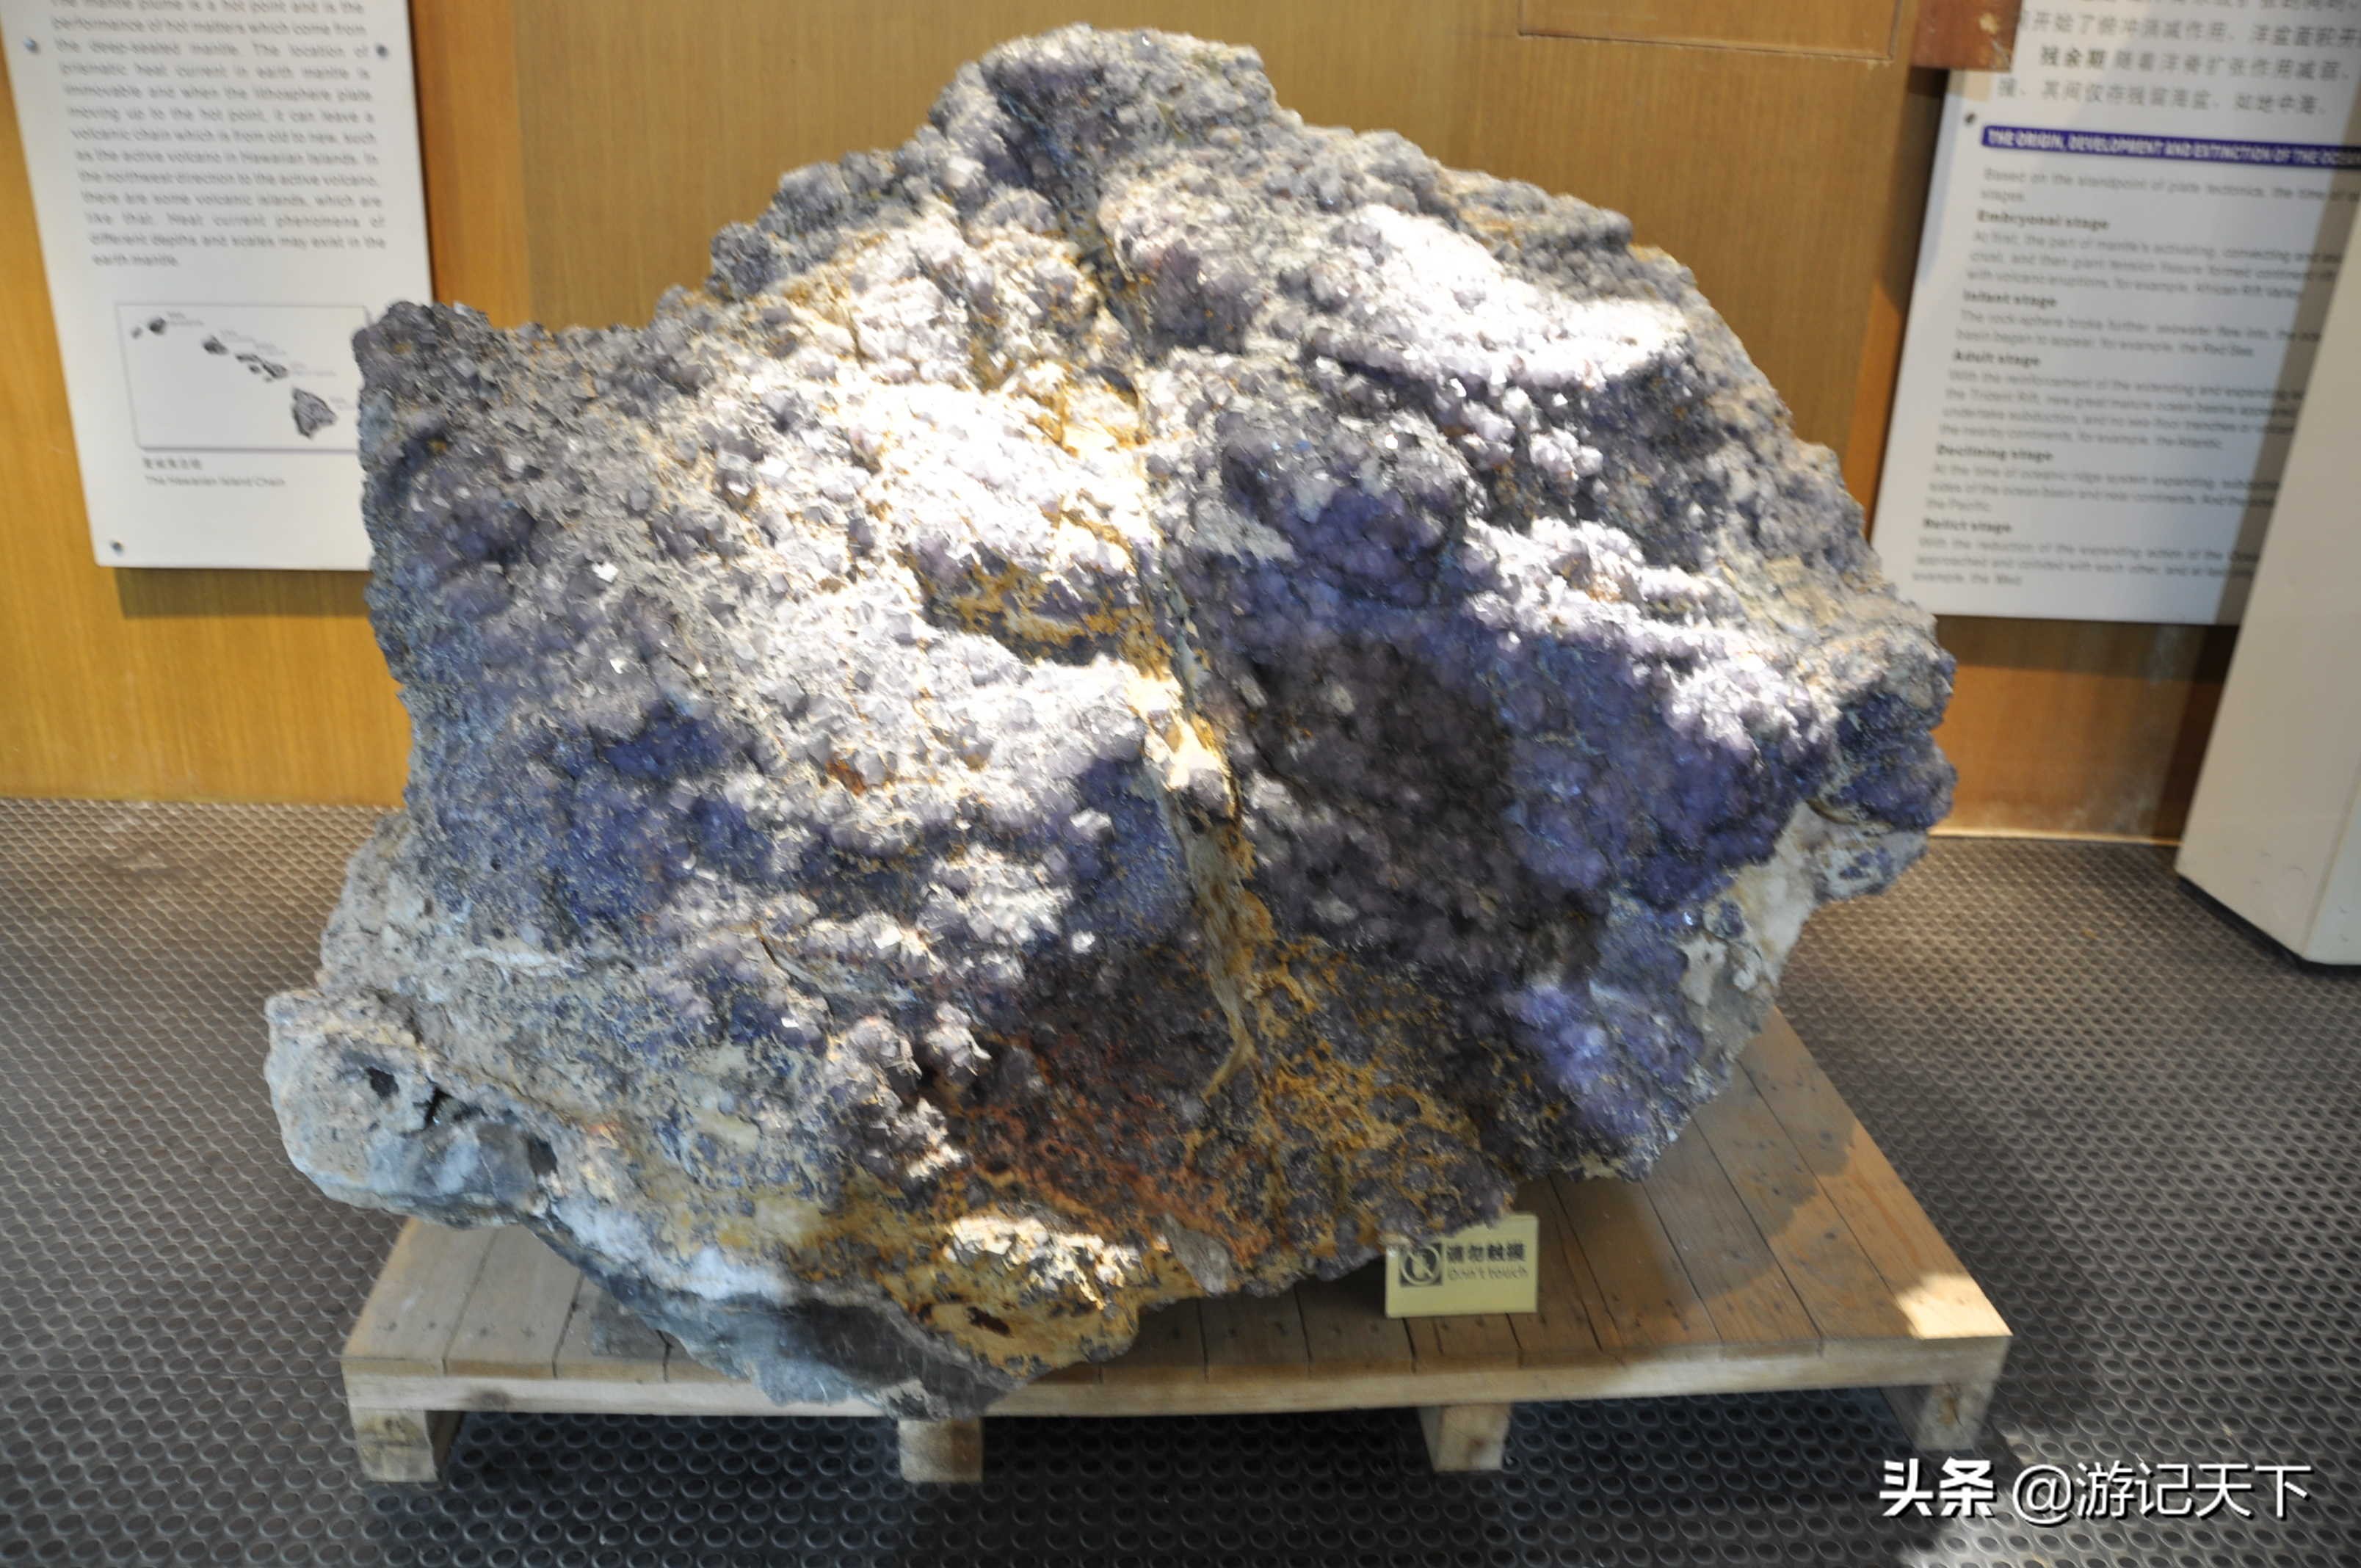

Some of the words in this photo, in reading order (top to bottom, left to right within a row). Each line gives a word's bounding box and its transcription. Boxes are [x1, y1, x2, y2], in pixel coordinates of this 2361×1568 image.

[1988, 129, 2014, 148] THE
[2067, 134, 2163, 156] DEVELOPMENT
[2164, 140, 2192, 158] AND
[2193, 142, 2271, 162] EXTINCTION
[2273, 147, 2291, 162] OF
